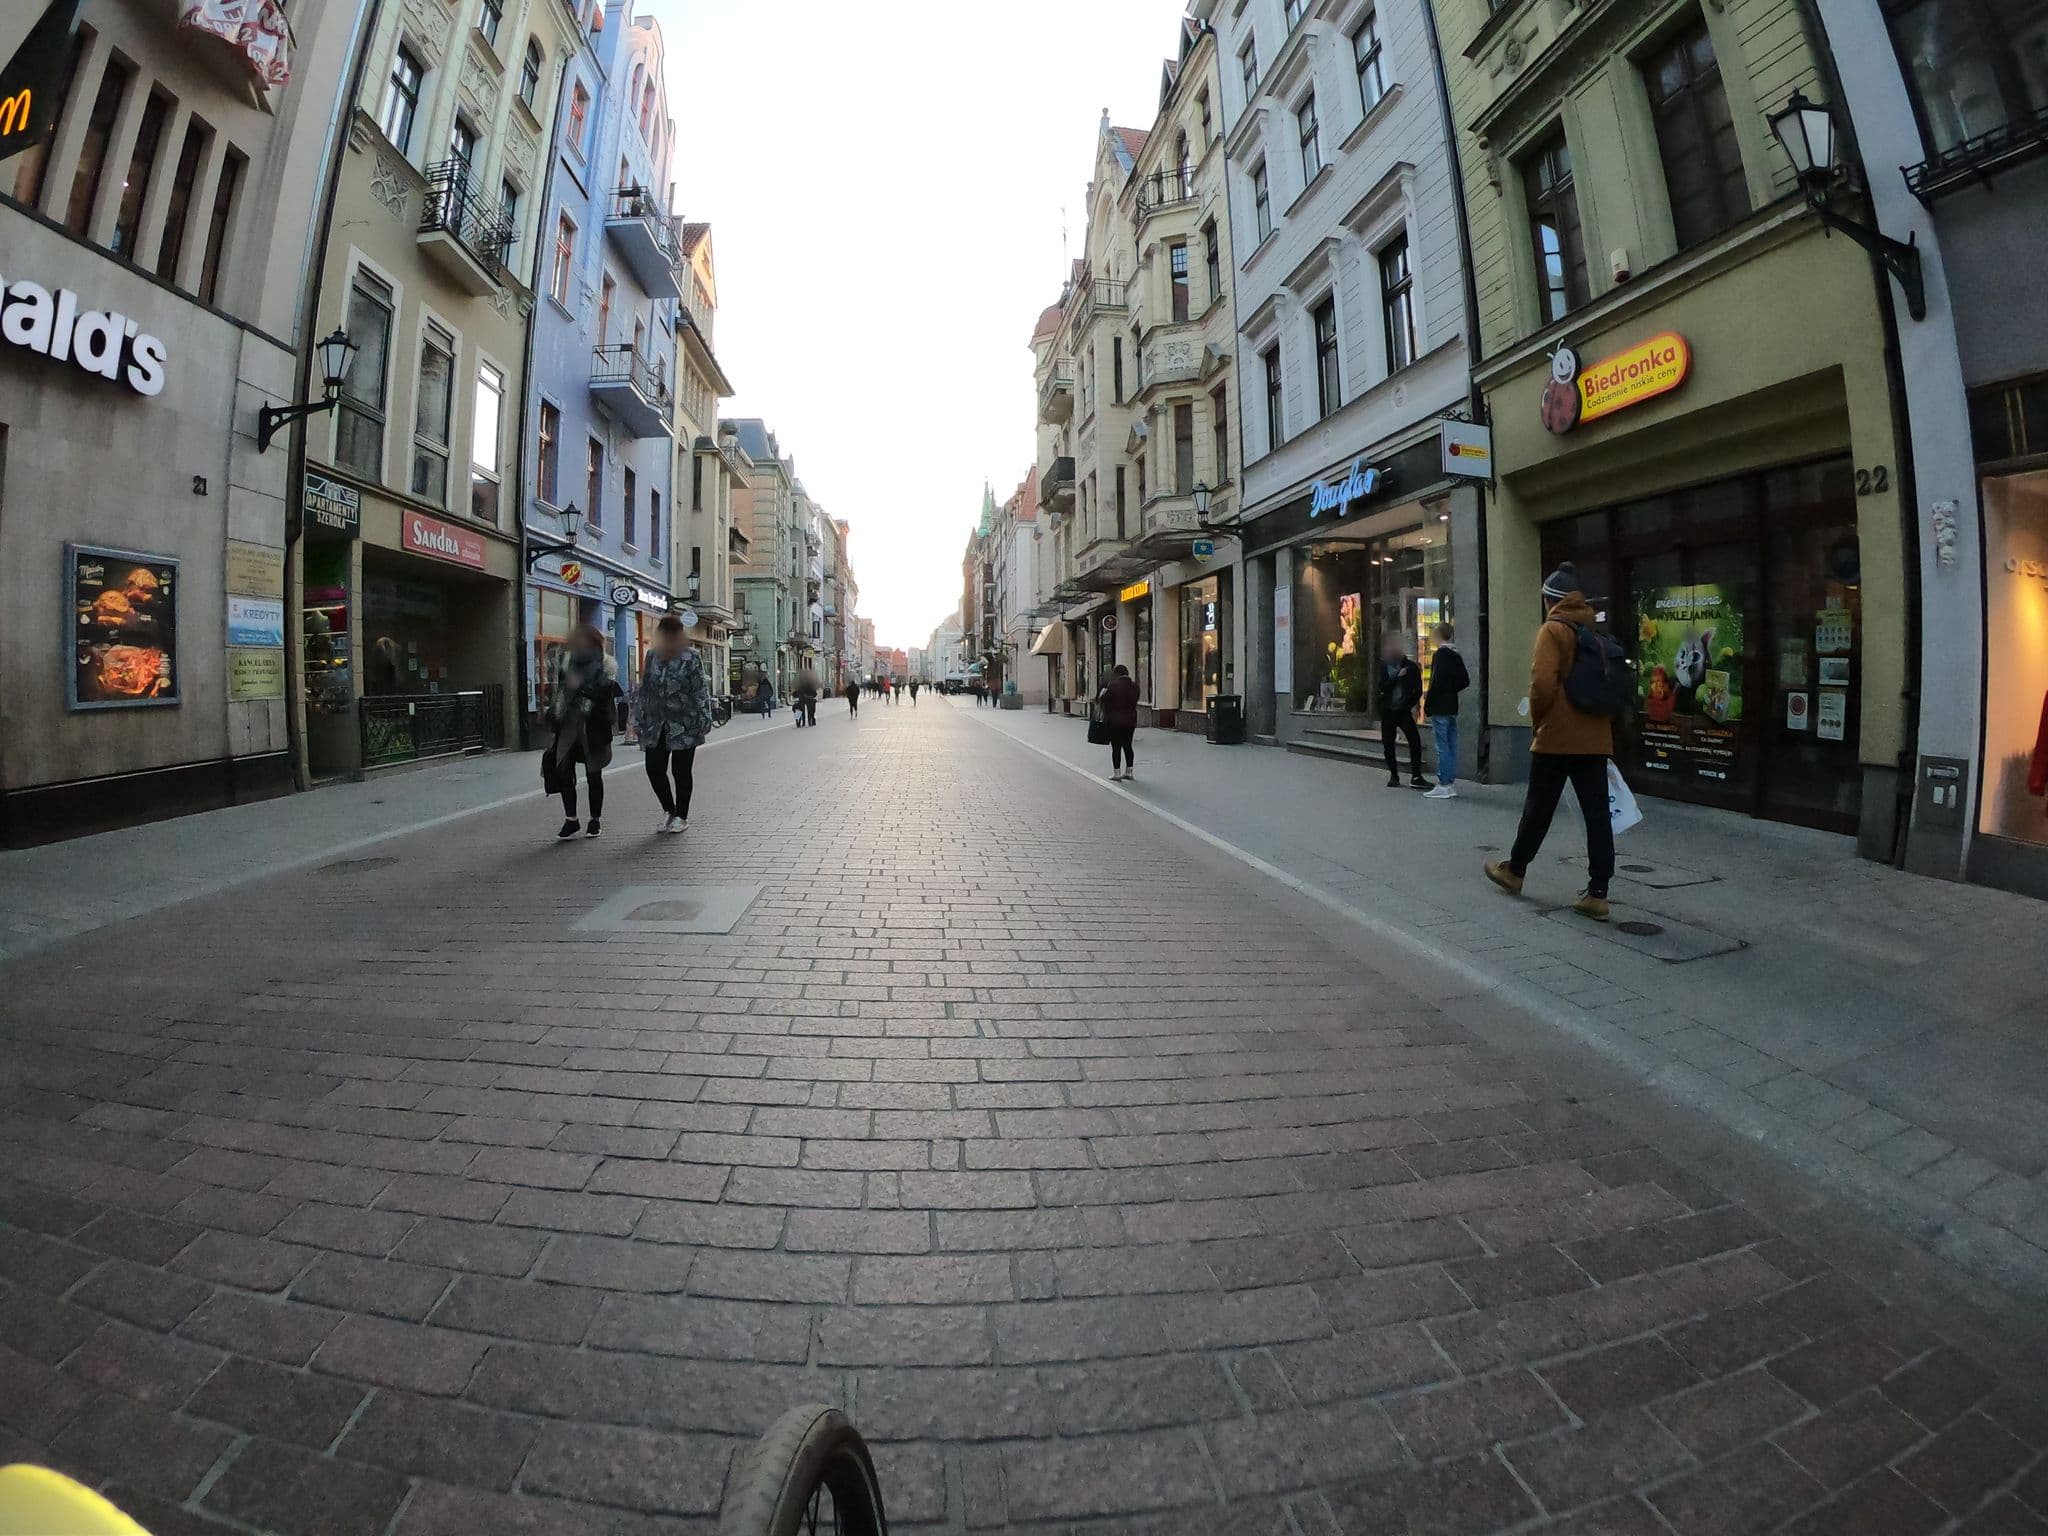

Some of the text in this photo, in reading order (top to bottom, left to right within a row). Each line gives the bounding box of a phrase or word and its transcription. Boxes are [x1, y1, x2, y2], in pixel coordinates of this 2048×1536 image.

[1584, 346, 1676, 398] Biedronka
[1586, 366, 1677, 409] Codziennie niskie ceny
[193, 475, 208, 496] 21
[1856, 464, 1889, 497] 22
[243, 608, 281, 621] KREDYTY
